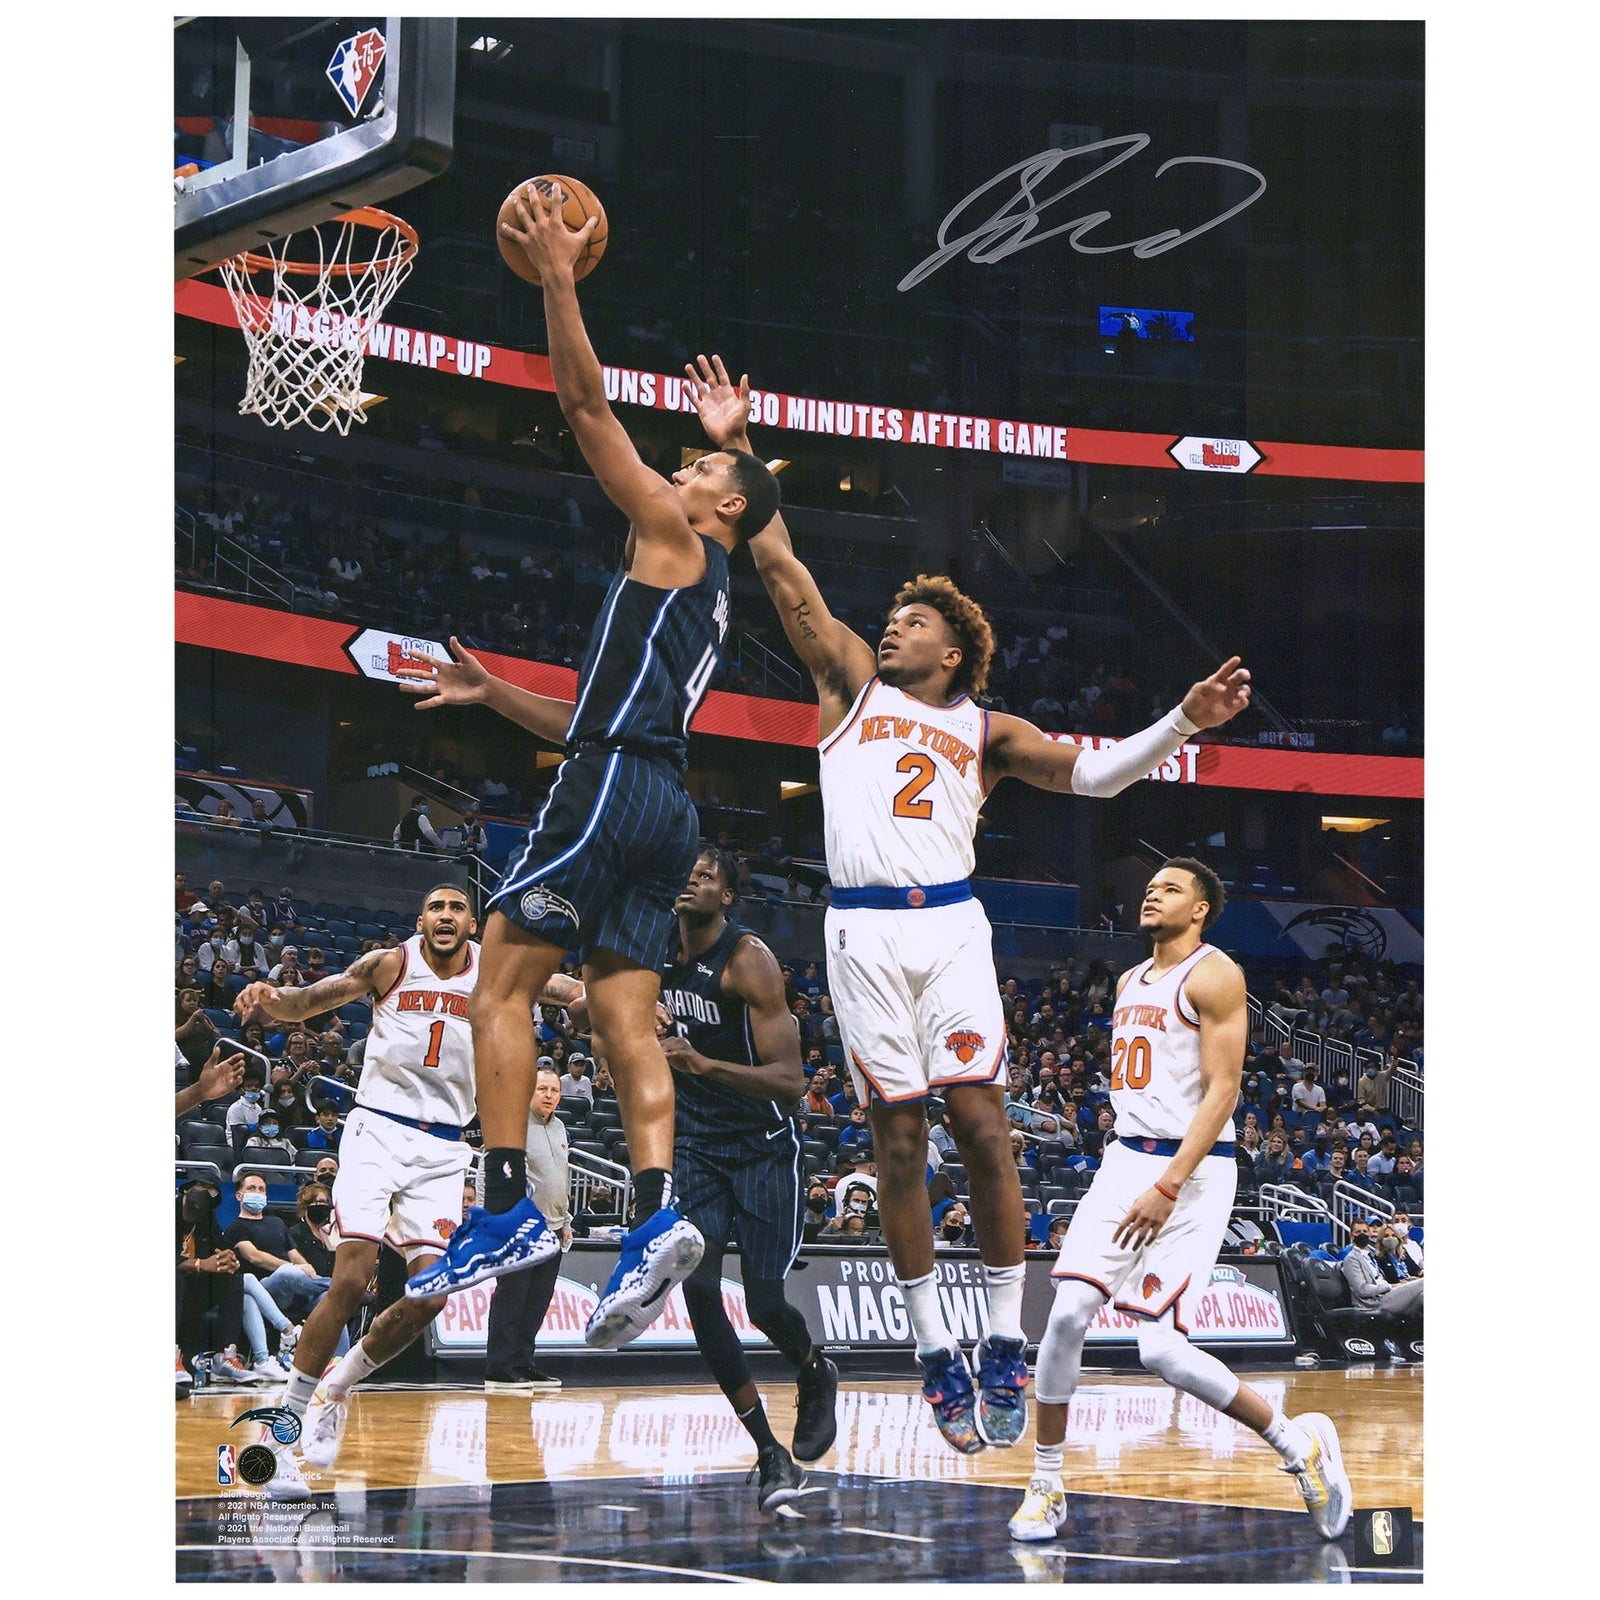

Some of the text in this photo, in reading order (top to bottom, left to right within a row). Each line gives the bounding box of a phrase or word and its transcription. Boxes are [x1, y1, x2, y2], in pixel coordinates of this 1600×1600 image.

[362, 41, 374, 68] 75
[368, 323, 491, 378] WRAP-UP
[602, 367, 656, 407] UNS
[748, 388, 779, 427] 30
[787, 396, 903, 442] MINUTES
[911, 411, 990, 451] AFTER
[998, 421, 1067, 460] GAME
[859, 715, 977, 779] NEW YORK
[893, 752, 937, 820] 2
[396, 990, 440, 1012] NEW
[1131, 1005, 1168, 1032] YORK
[423, 1020, 446, 1067] 1
[1109, 1036, 1151, 1091] 20
[443, 1289, 495, 1332] PAP
